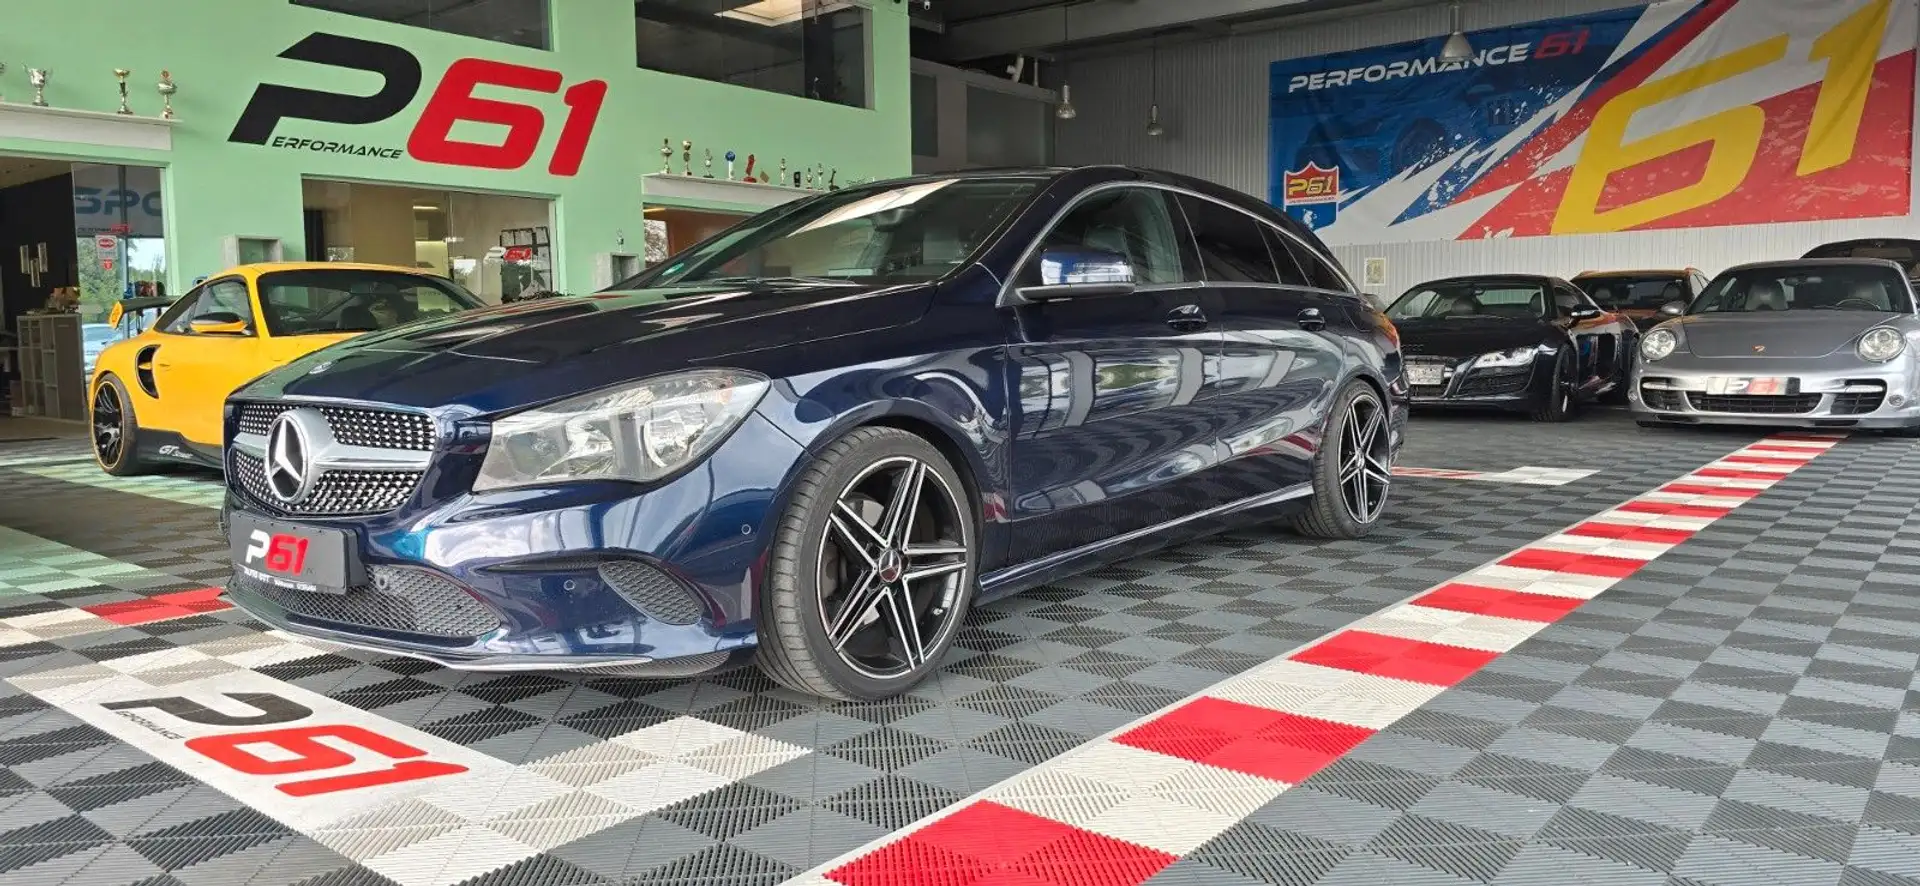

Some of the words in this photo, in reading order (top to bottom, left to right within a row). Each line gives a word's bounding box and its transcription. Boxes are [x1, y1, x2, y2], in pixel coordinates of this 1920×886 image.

[1532, 29, 1590, 60] 61
[227, 31, 608, 177] P61
[1551, 0, 1893, 235] 61
[1288, 175, 1334, 196] P61
[245, 529, 310, 576] P61
[100, 692, 470, 798] P61
